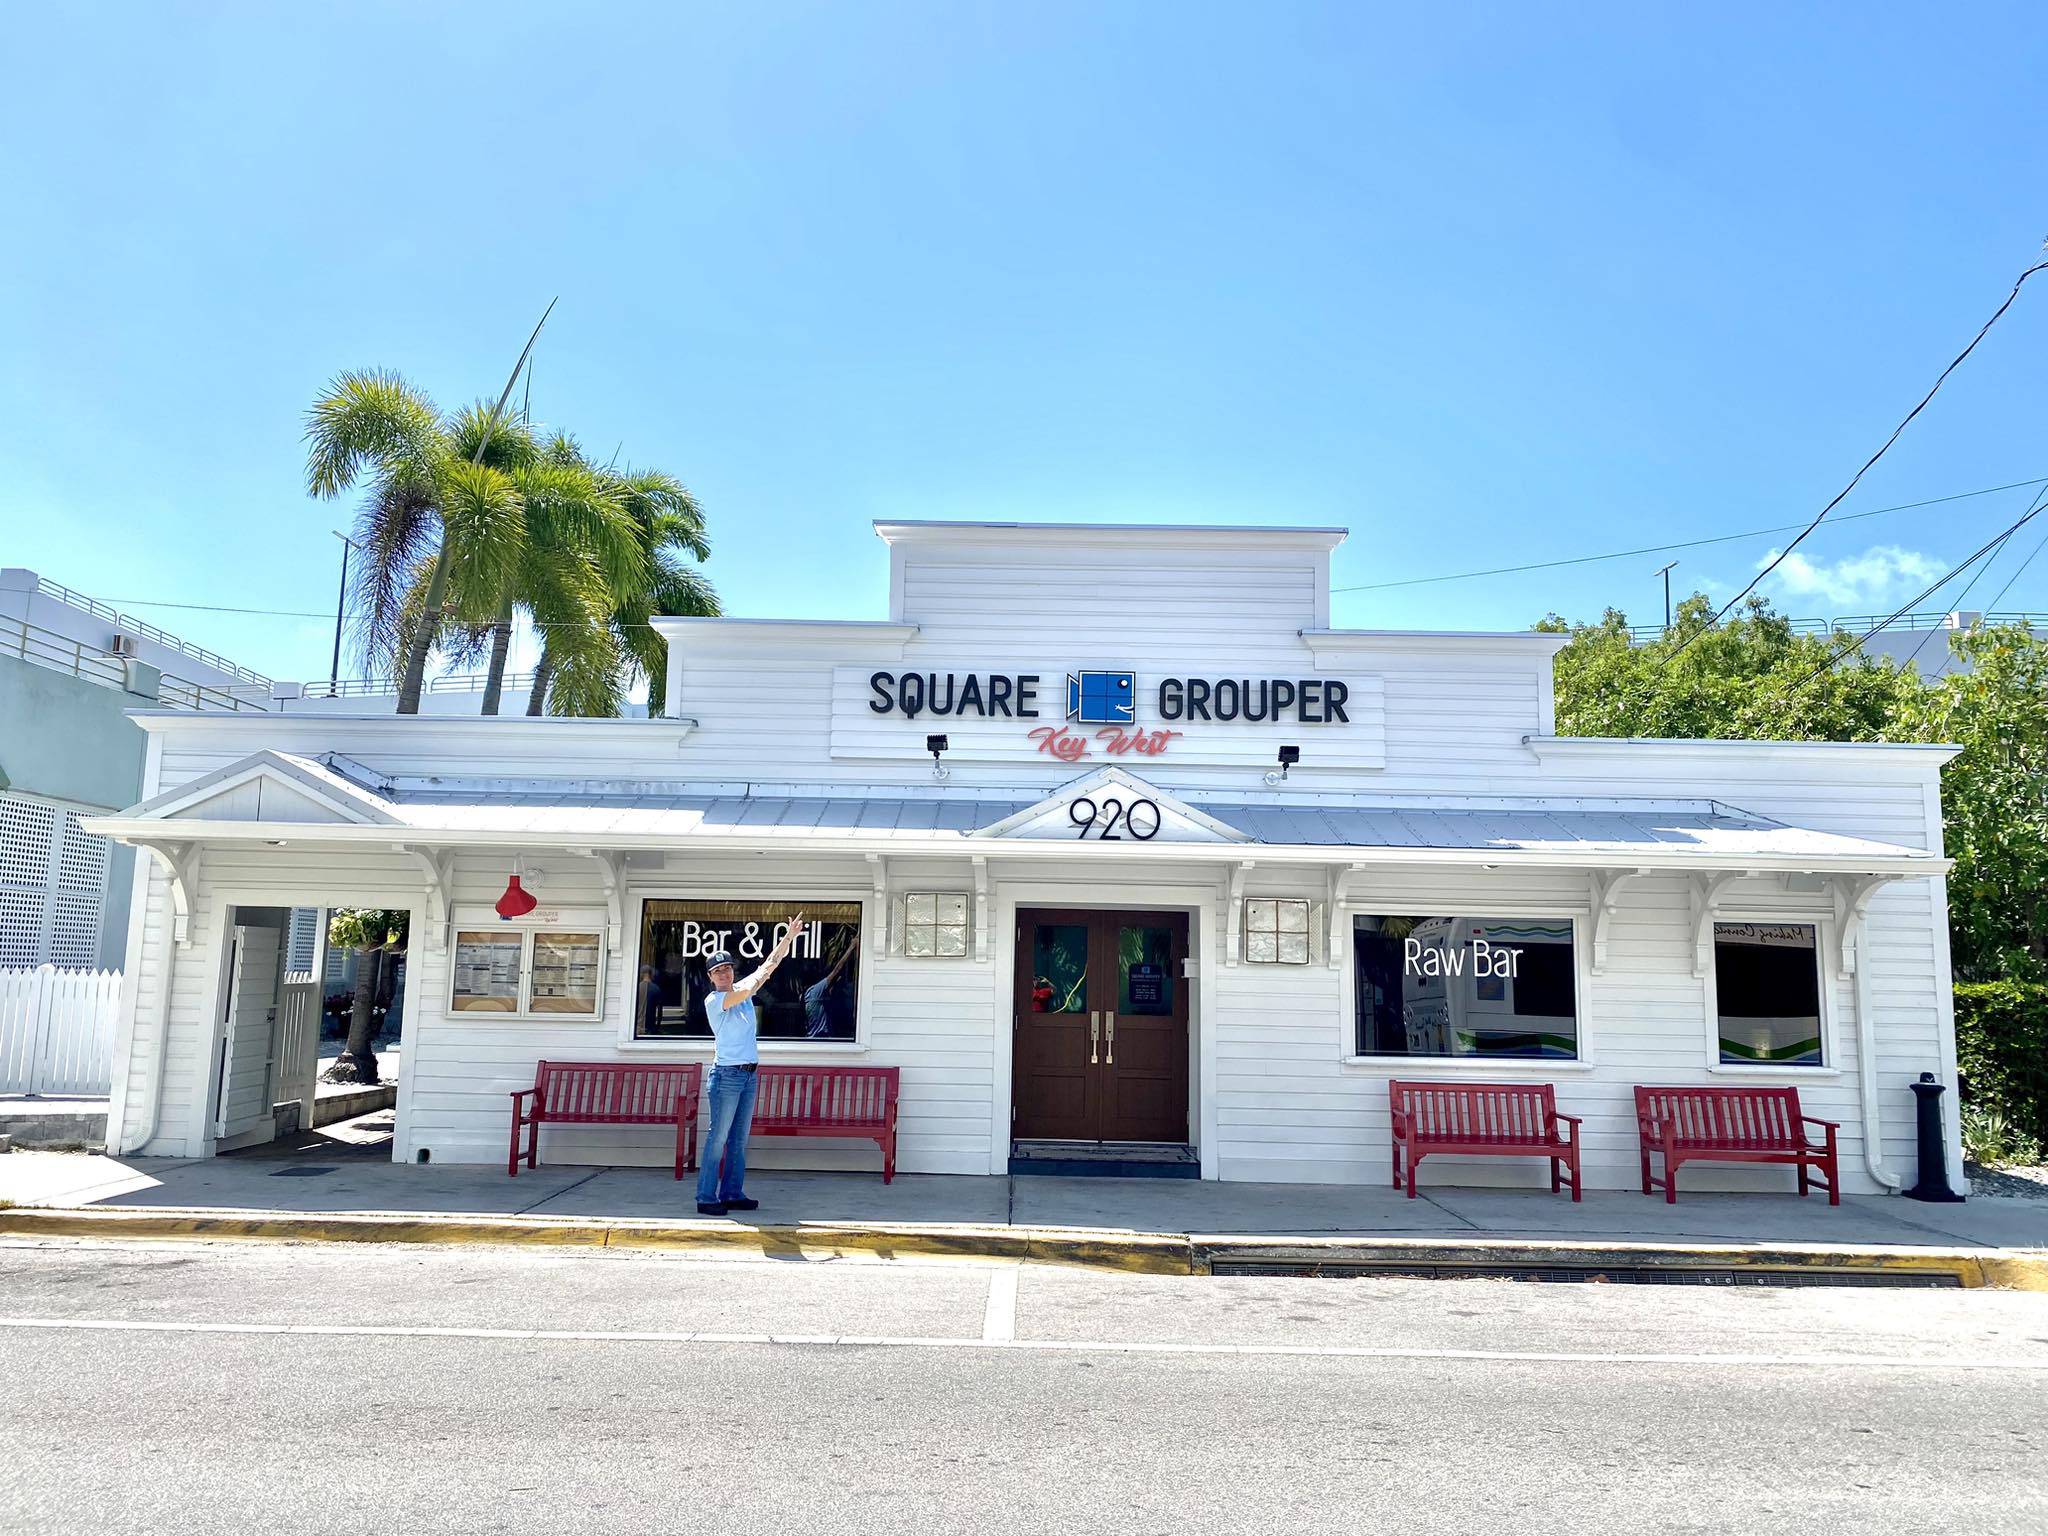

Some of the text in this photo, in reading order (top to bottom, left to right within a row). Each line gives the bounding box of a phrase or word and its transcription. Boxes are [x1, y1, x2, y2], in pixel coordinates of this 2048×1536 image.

[869, 671, 1350, 723] SQUARE GROUPER
[1027, 726, 1184, 762] Key West
[1069, 798, 1161, 841] 920
[682, 921, 732, 958] Bar
[738, 921, 764, 959] &
[1404, 938, 1524, 978] Raw Bar
